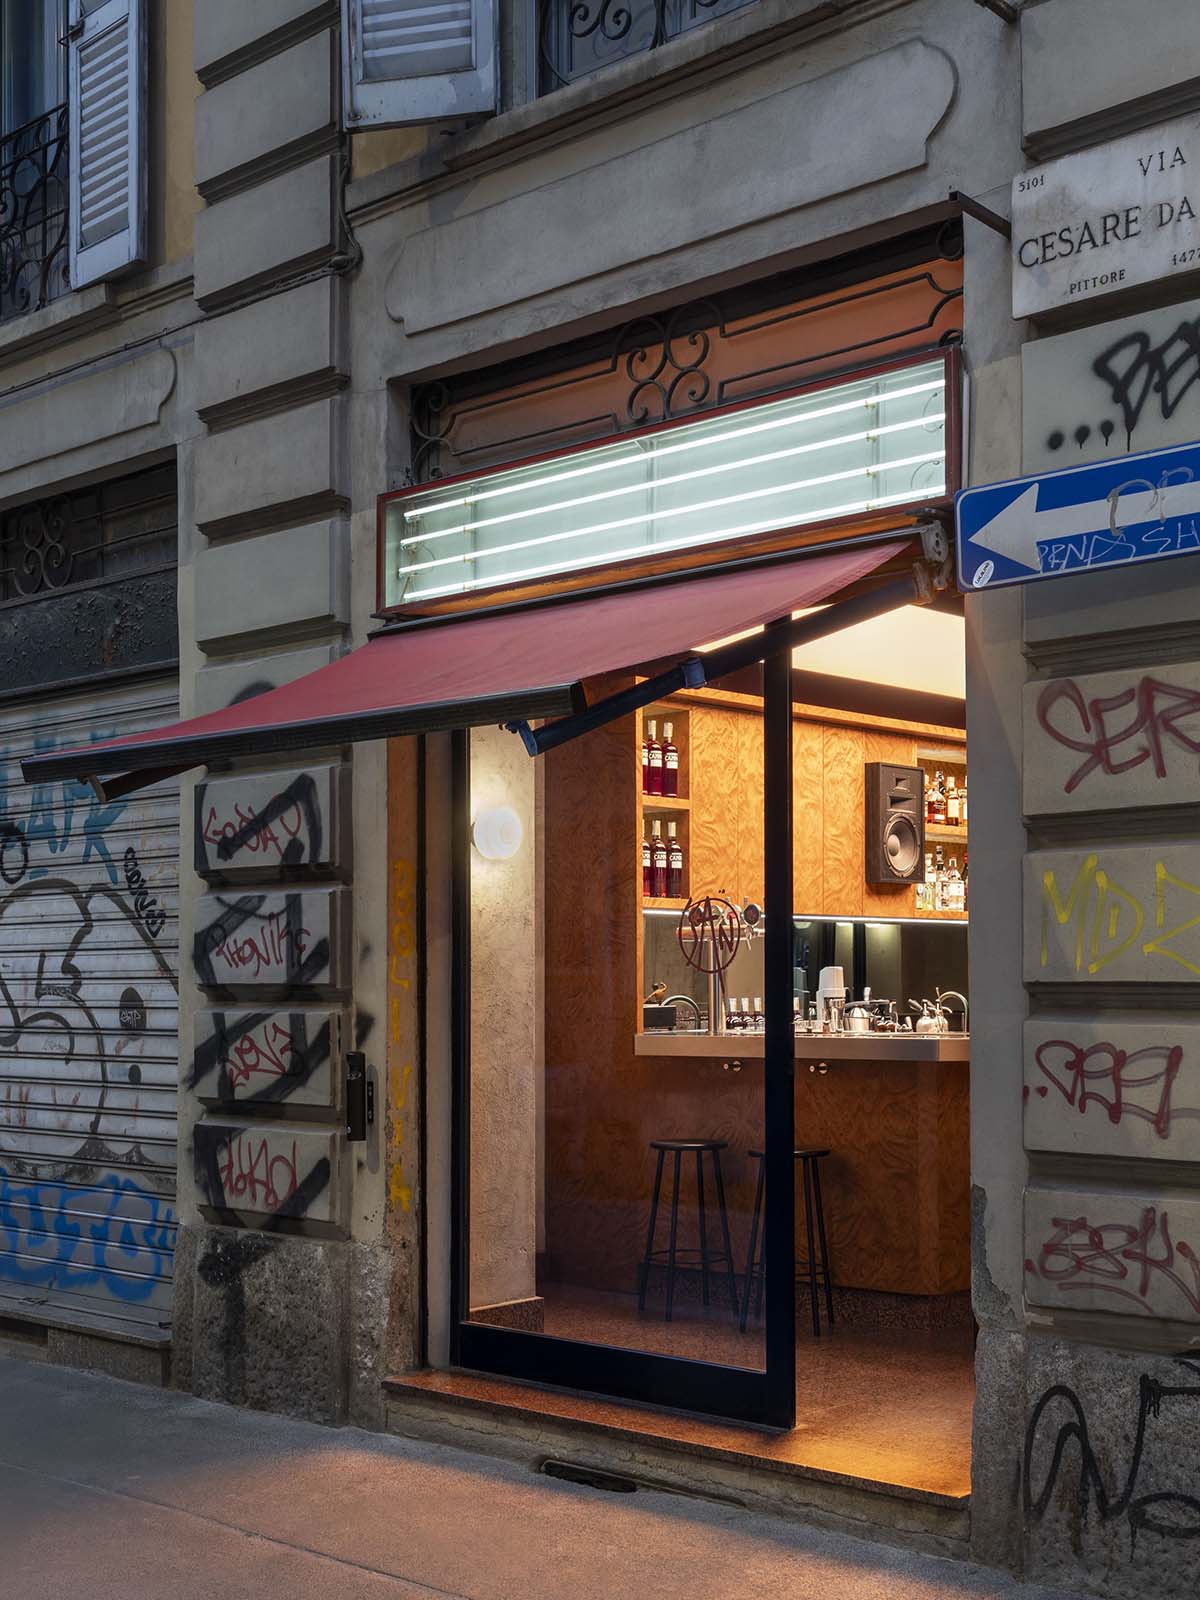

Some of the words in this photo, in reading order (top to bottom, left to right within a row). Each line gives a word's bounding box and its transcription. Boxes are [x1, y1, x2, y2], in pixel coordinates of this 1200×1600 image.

[1137, 146, 1186, 176] VIA
[1018, 206, 1142, 268] CESARE
[1157, 196, 1196, 228] DA
[1069, 269, 1126, 295] PITTORE
[393, 860, 415, 1213] BOLIVIA
